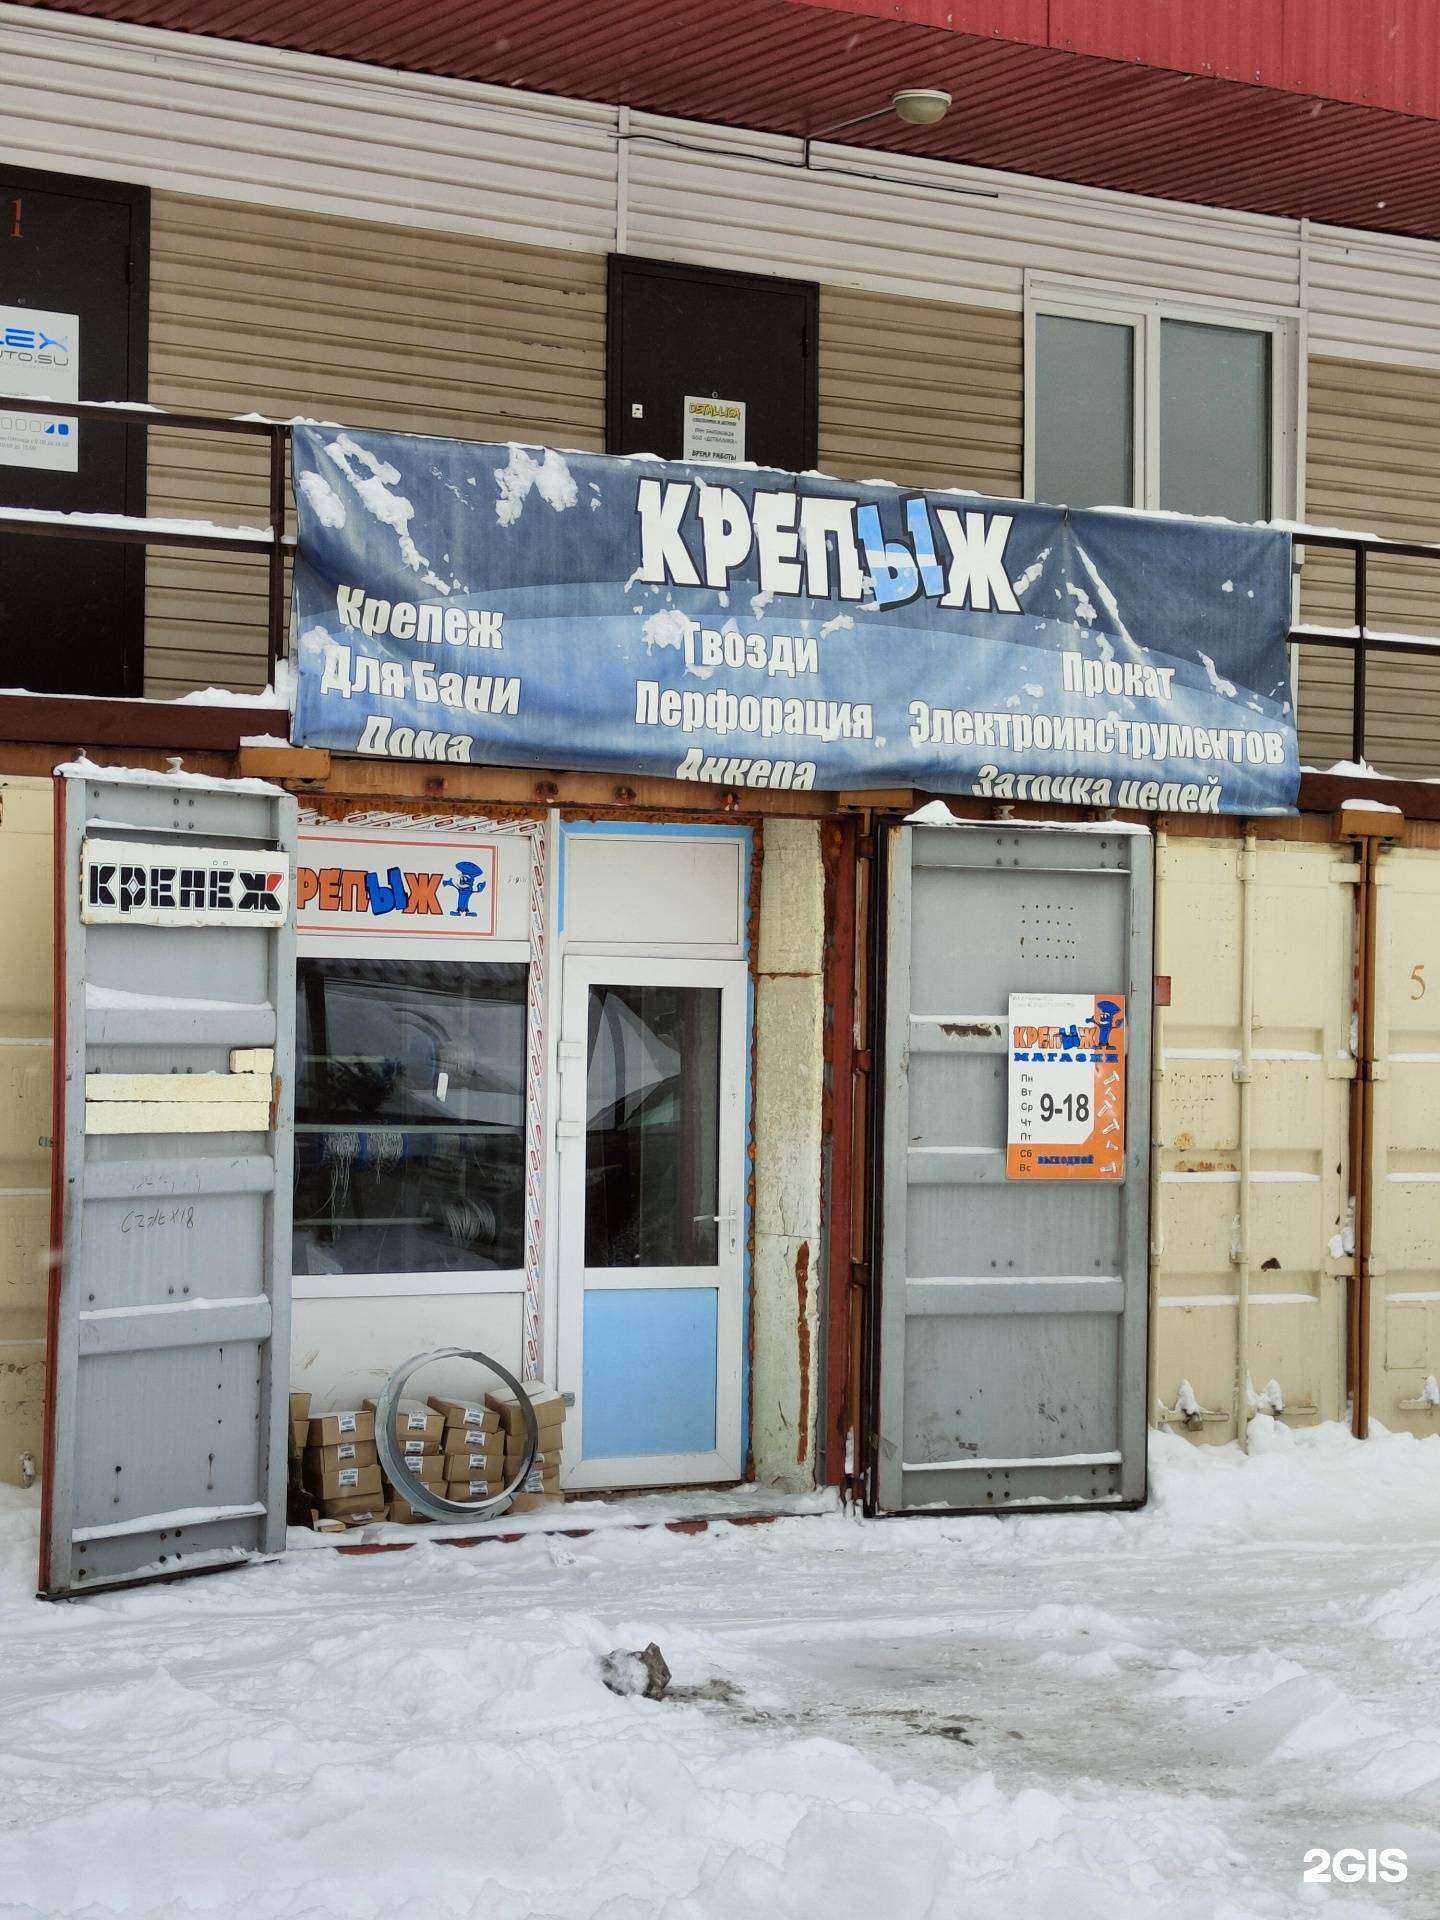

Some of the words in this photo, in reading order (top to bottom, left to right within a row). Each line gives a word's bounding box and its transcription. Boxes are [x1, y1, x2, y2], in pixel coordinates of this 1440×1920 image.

[9, 197, 24, 239] 1
[0, 327, 69, 353] EX
[636, 475, 1024, 611] КРЕПЫЖ
[335, 584, 505, 650] Крепеж
[682, 620, 819, 679] Гвозди
[320, 644, 407, 699] Для
[406, 660, 522, 715] Бани
[1061, 650, 1176, 700] Прокат
[634, 679, 875, 740] Перфорация
[356, 714, 474, 764] Дома
[908, 700, 1286, 766] Электроинструментов
[971, 764, 1112, 808] Заточка
[297, 866, 443, 916] РЕПЫЖ
[1409, 964, 1427, 1001] 5
[1013, 1024, 1099, 1050] КРЕПЫЖ
[1021, 1074, 1034, 1083] Пн
[1021, 1088, 1032, 1097] Вт
[1020, 1103, 1033, 1114] Ср
[1020, 1119, 1032, 1129] Чт
[1040, 1093, 1090, 1123] 9-18
[1019, 1149, 1033, 1158] Сб
[1020, 1132, 1032, 1141] Пт
[1019, 1163, 1031, 1172] Вс
